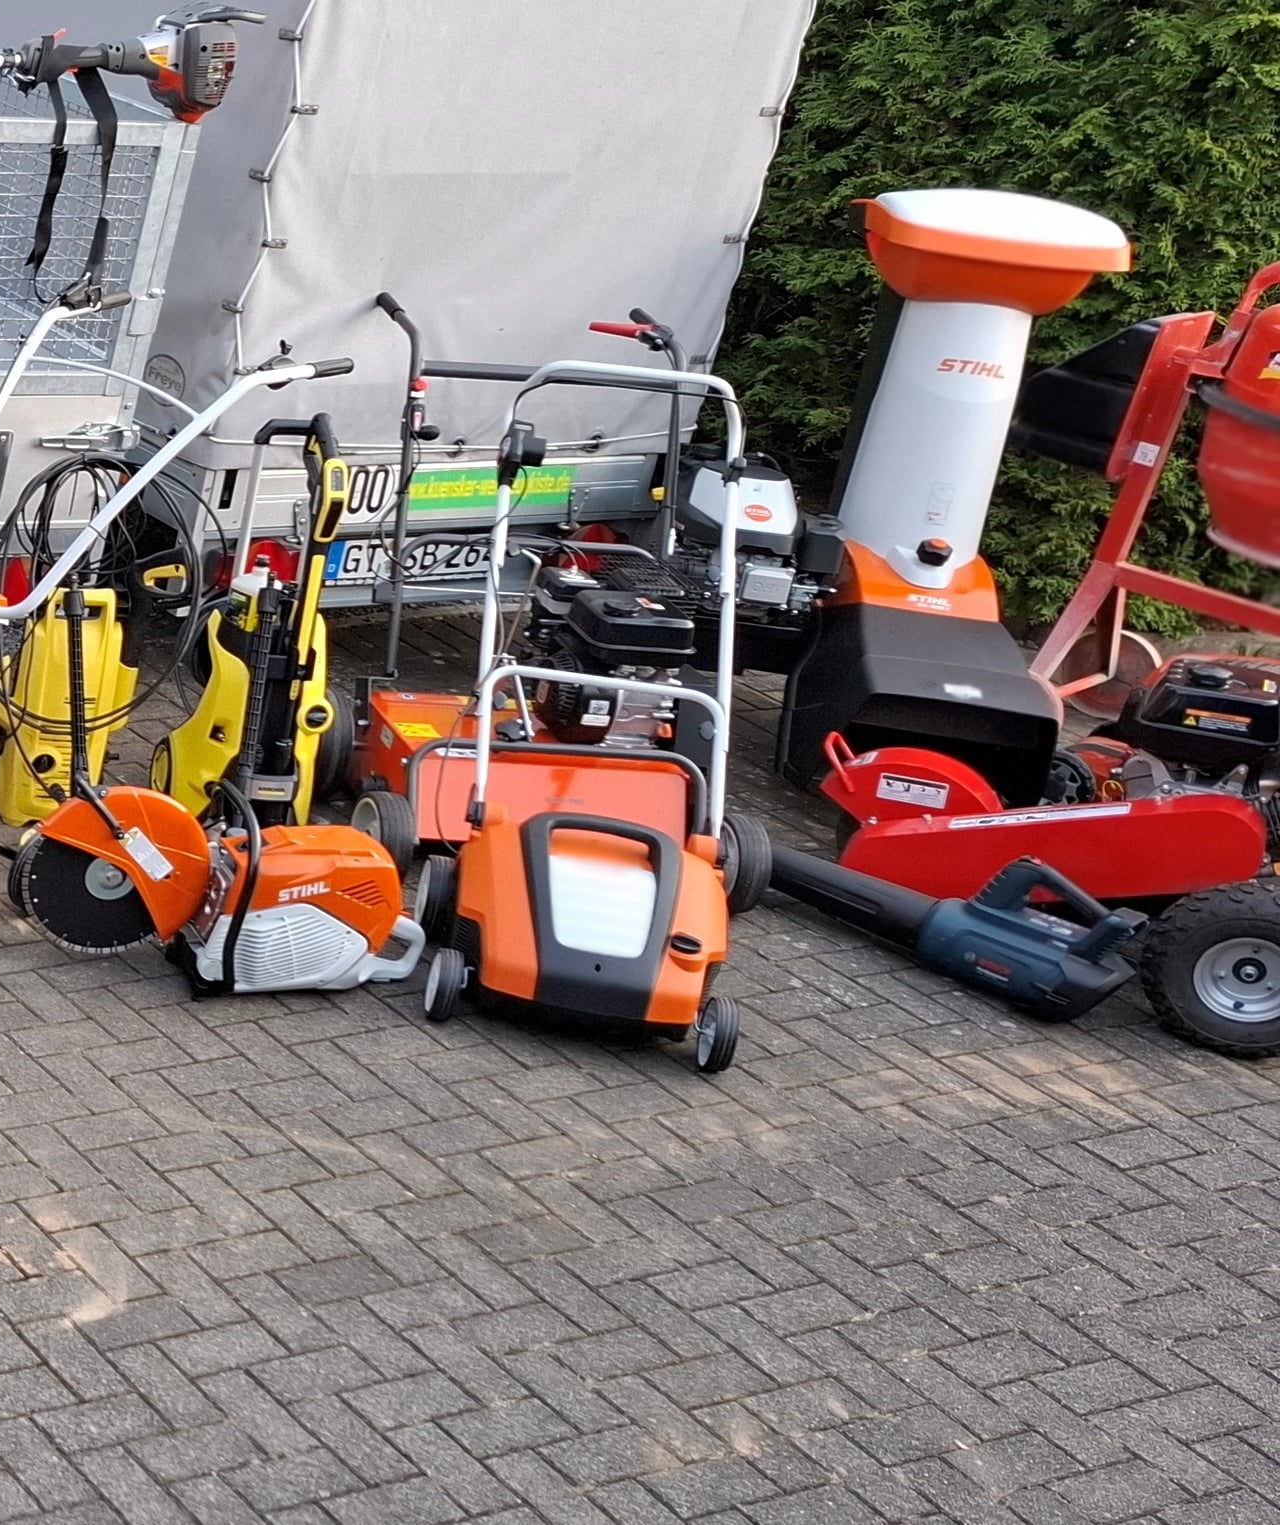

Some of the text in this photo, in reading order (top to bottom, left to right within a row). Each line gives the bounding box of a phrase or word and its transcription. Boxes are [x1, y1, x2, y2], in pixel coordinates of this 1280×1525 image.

[148, 366, 181, 392] Freye
[937, 358, 1005, 380] STIHL
[347, 467, 390, 514] 00
[343, 544, 383, 573] GT
[277, 881, 330, 902] STIHL
